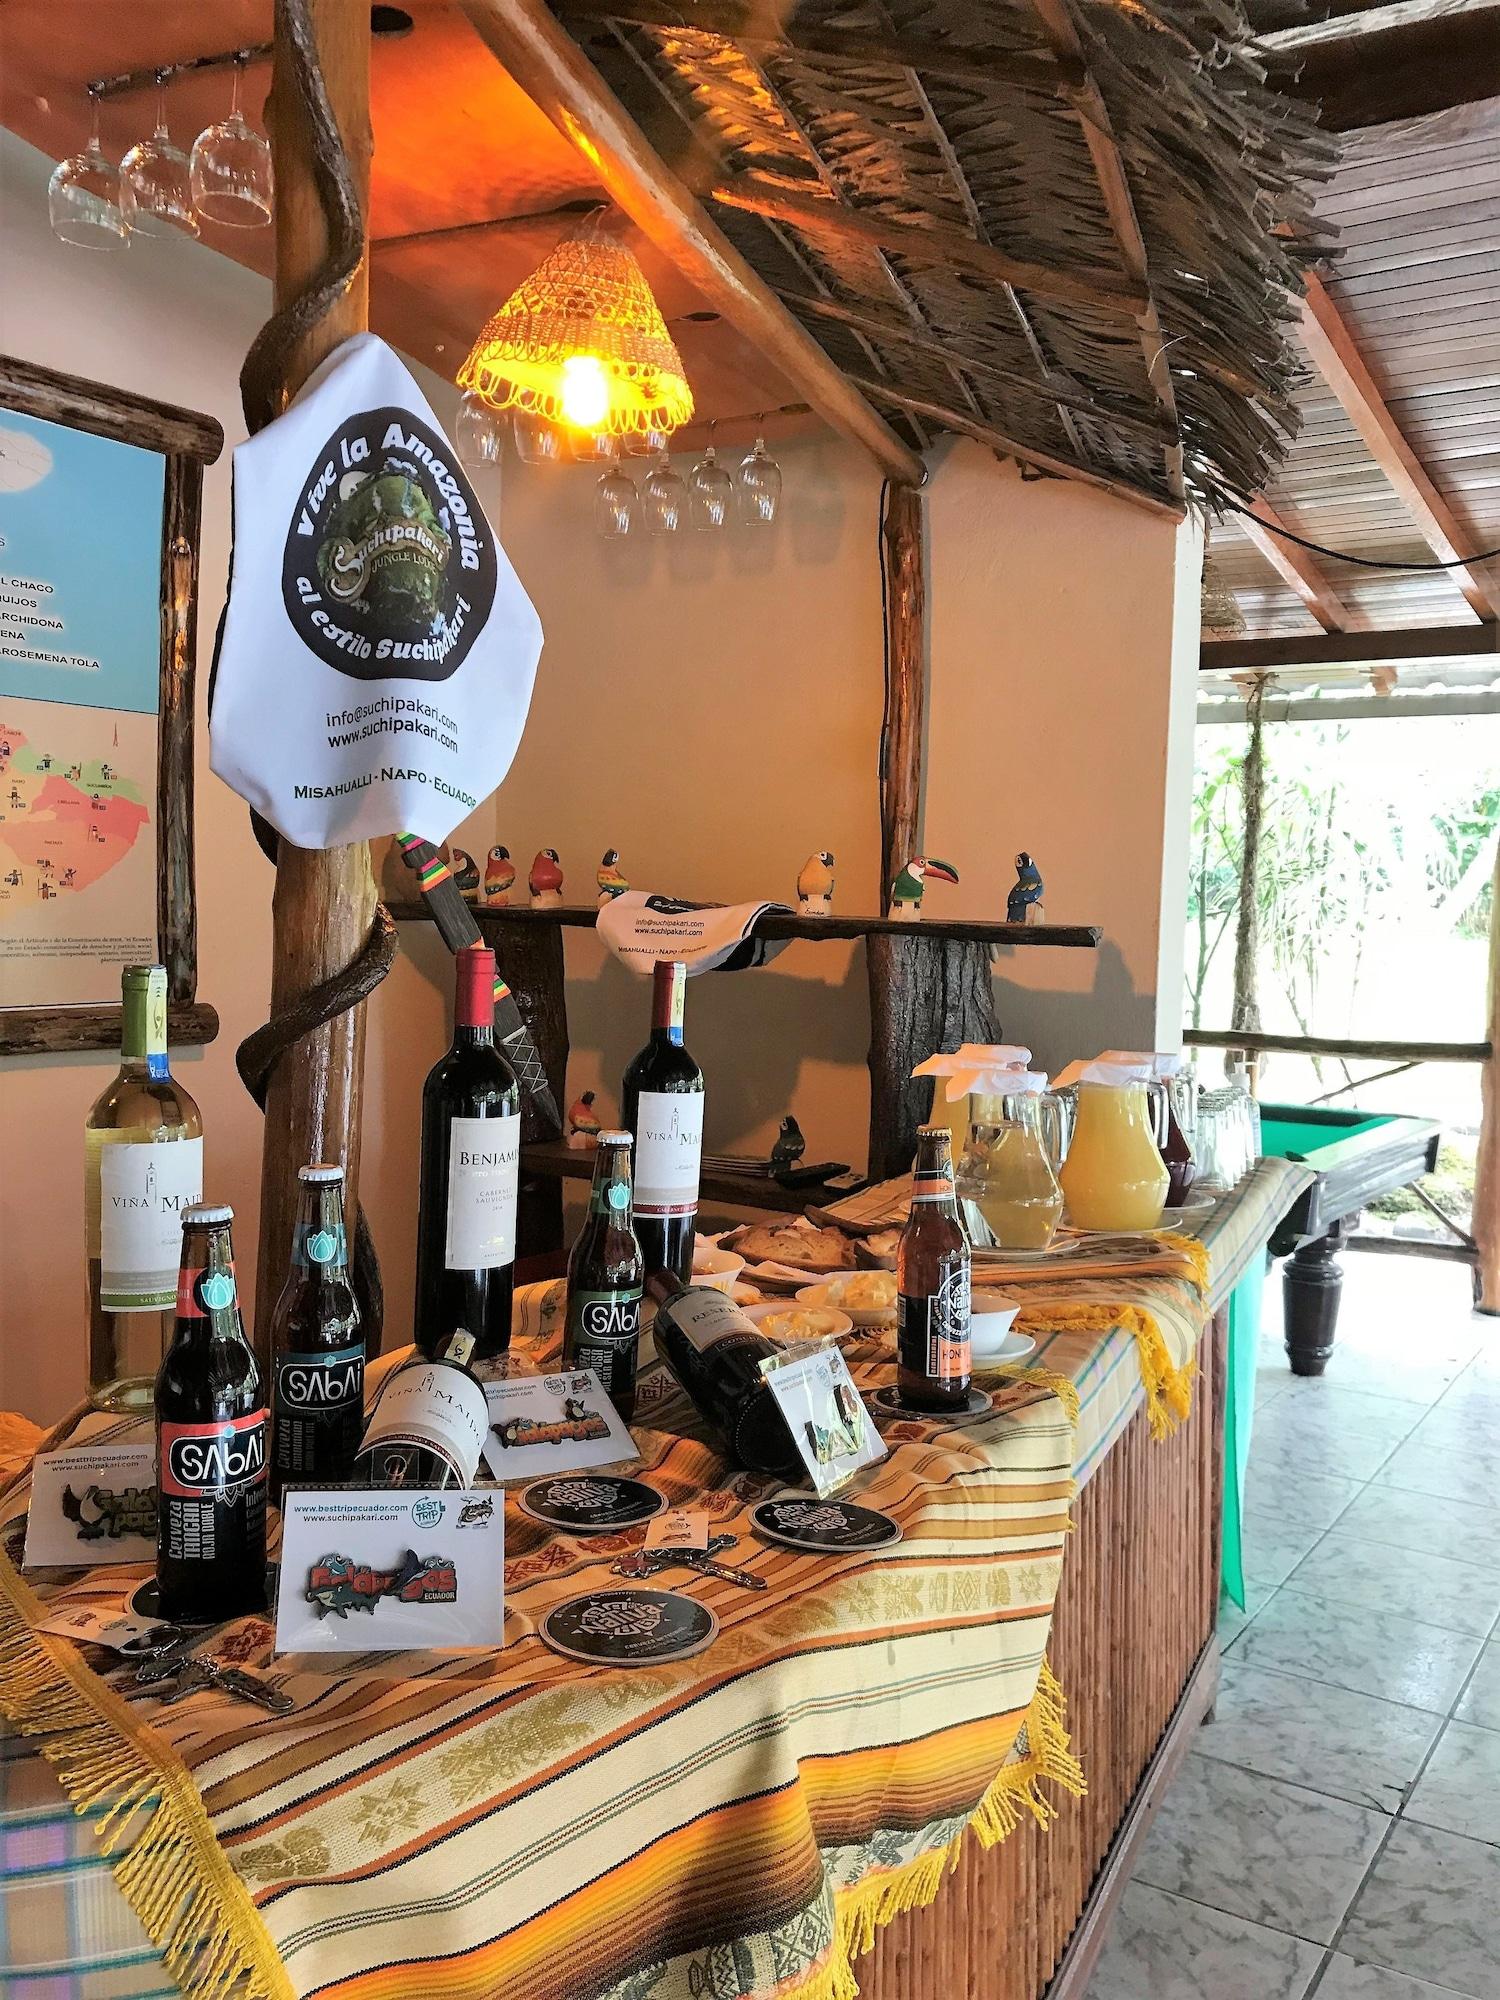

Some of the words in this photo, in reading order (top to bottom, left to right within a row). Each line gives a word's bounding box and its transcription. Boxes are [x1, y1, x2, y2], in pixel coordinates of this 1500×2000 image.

[297, 460, 337, 536] Vive
[340, 436, 371, 468] la
[381, 423, 483, 571] Amazonia
[331, 525, 444, 596] Suchipakari
[372, 552, 411, 573] JUNGLE
[11, 579, 54, 594] CHACO
[296, 577, 322, 605] al
[311, 610, 371, 659] estilo
[375, 593, 471, 664] Suchipakari
[70, 657, 100, 669] TOLA
[326, 696, 458, 734] info@suchipakari.com
[328, 716, 458, 753] www.suchipakari.com
[294, 773, 372, 799] MISAHUALLI
[381, 767, 427, 784] NAPO
[434, 776, 477, 809] ECUADOR
[634, 927, 703, 936] www.suchipakari.com
[645, 1131, 672, 1141] VIÑA
[112, 1196, 150, 1208] VIÑA
[140, 1294, 177, 1303] SAUVIGNO
[591, 1302, 640, 1334] SAbA
[200, 1502, 215, 1532] DOBLE
[294, 1504, 408, 1513] www.besttripecuador.com
[416, 1501, 438, 1512] BEST
[303, 1513, 398, 1522] www.suchipakari.com
[415, 1510, 439, 1522] TRIP
[168, 1500, 183, 1560] Cerveza
[424, 1591, 455, 1600] ECUADOR
